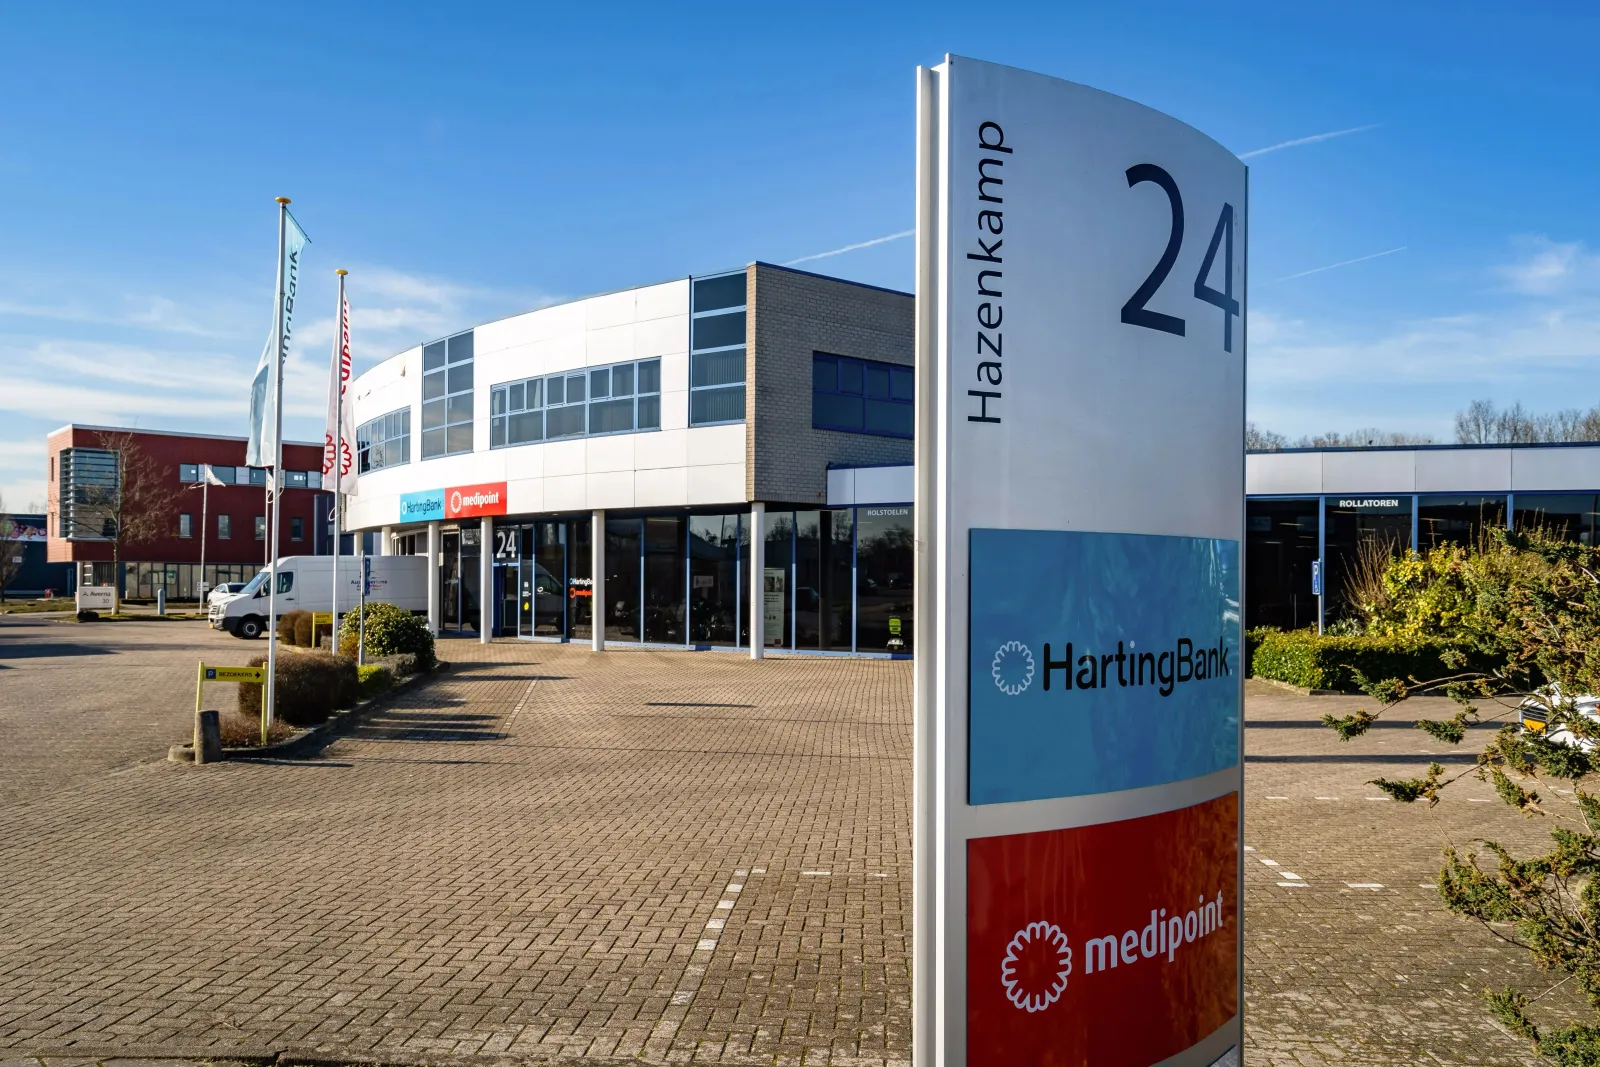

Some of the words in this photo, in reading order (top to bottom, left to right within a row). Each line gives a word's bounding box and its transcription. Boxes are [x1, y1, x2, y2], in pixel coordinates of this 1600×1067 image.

[966, 120, 1013, 424] Hazenkamp
[1120, 163, 1240, 353] 24
[462, 491, 499, 508] medipoint
[867, 508, 909, 516] ROLSTOELEN
[1339, 499, 1399, 508] ROLLATOREN
[496, 530, 517, 559] 24
[1085, 889, 1224, 975] medipoint
